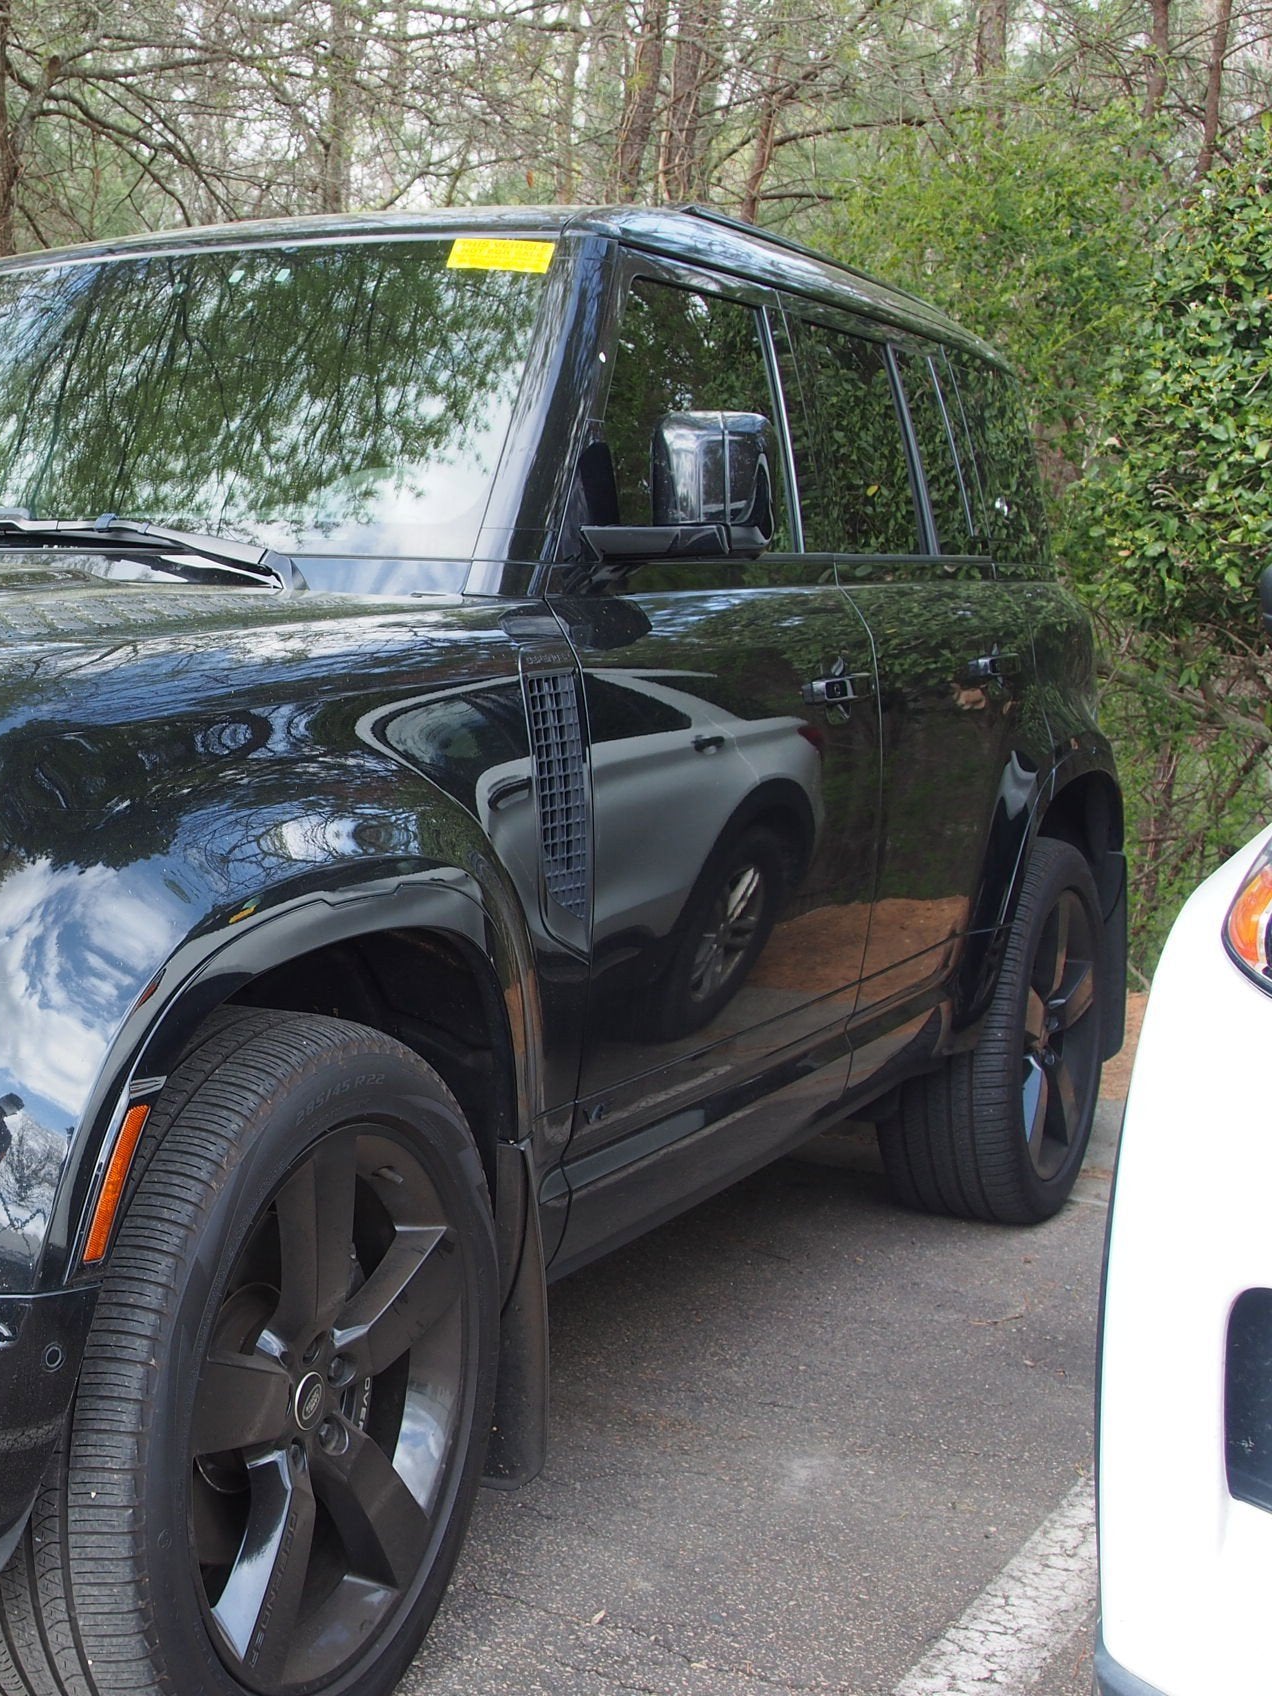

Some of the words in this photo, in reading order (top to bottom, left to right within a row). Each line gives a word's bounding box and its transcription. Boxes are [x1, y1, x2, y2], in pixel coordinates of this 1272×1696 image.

[295, 1078, 351, 1127] 285/45
[353, 1073, 385, 1089] R22
[358, 1376, 371, 1431] OVER
[249, 1512, 298, 1668] DEFENDER
